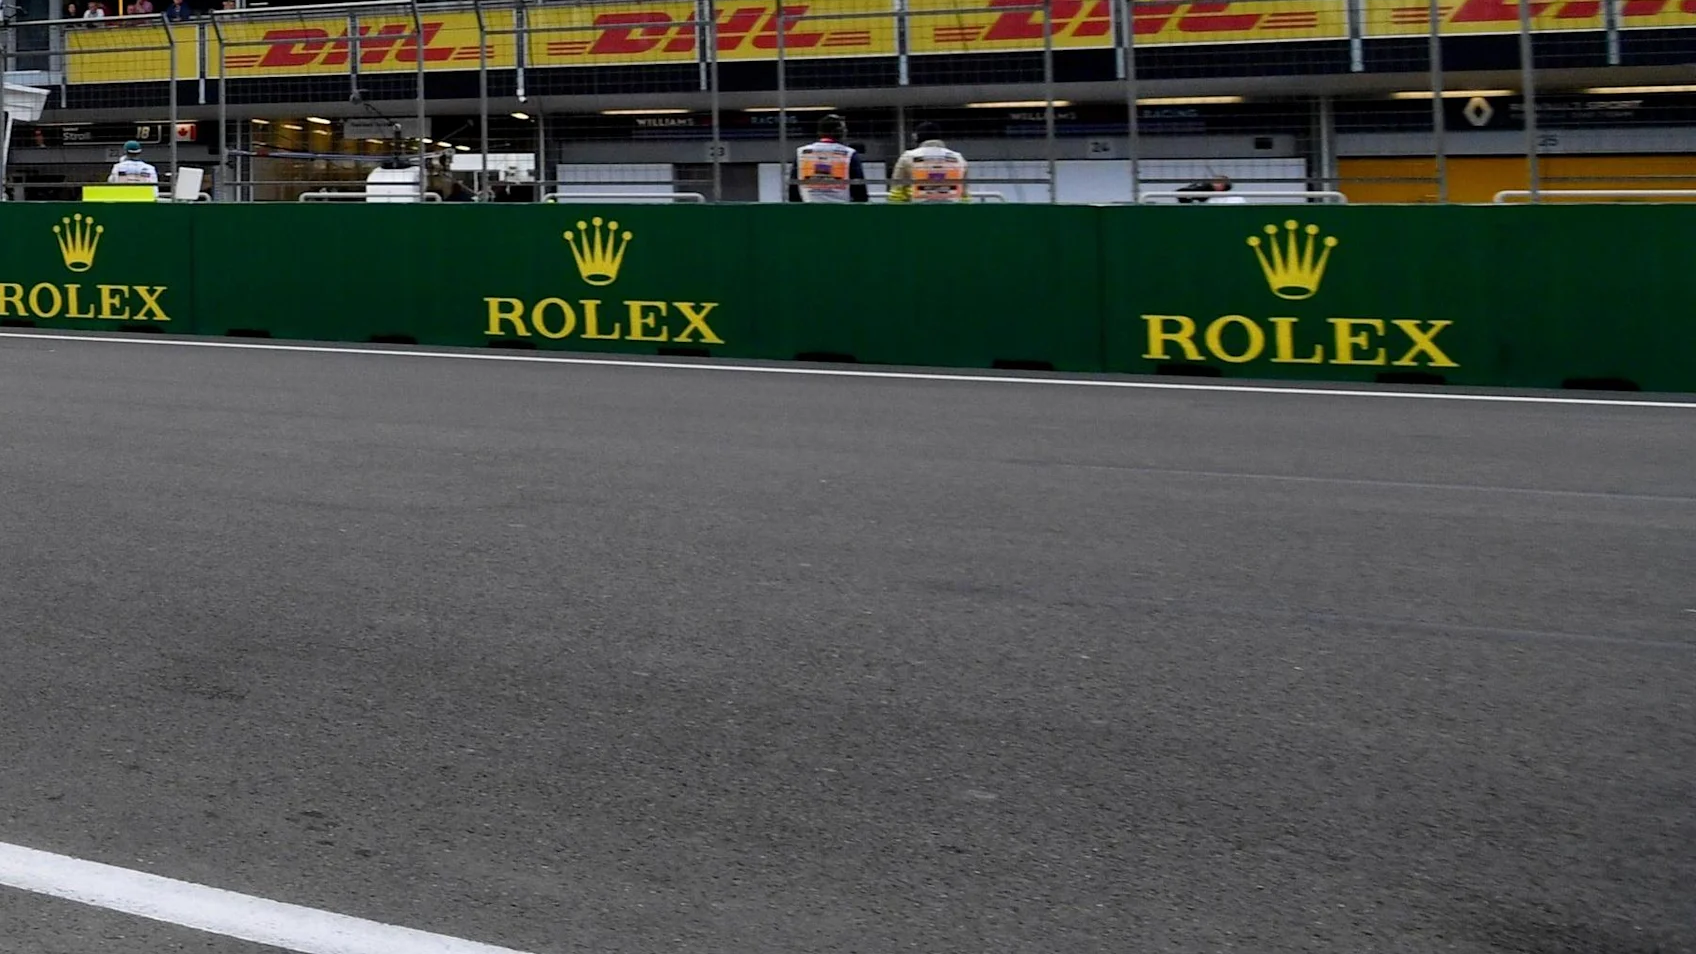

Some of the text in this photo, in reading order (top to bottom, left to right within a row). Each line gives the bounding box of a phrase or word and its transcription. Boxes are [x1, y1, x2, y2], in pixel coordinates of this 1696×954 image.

[257, 22, 455, 67] DHL
[588, 4, 826, 55] DHL
[136, 126, 151, 140] 18
[636, 118, 695, 127] WILLIAMS
[1008, 112, 1077, 121] WILLAMS
[484, 296, 725, 344] ROLEX
[1141, 314, 1460, 367] ROLEX
